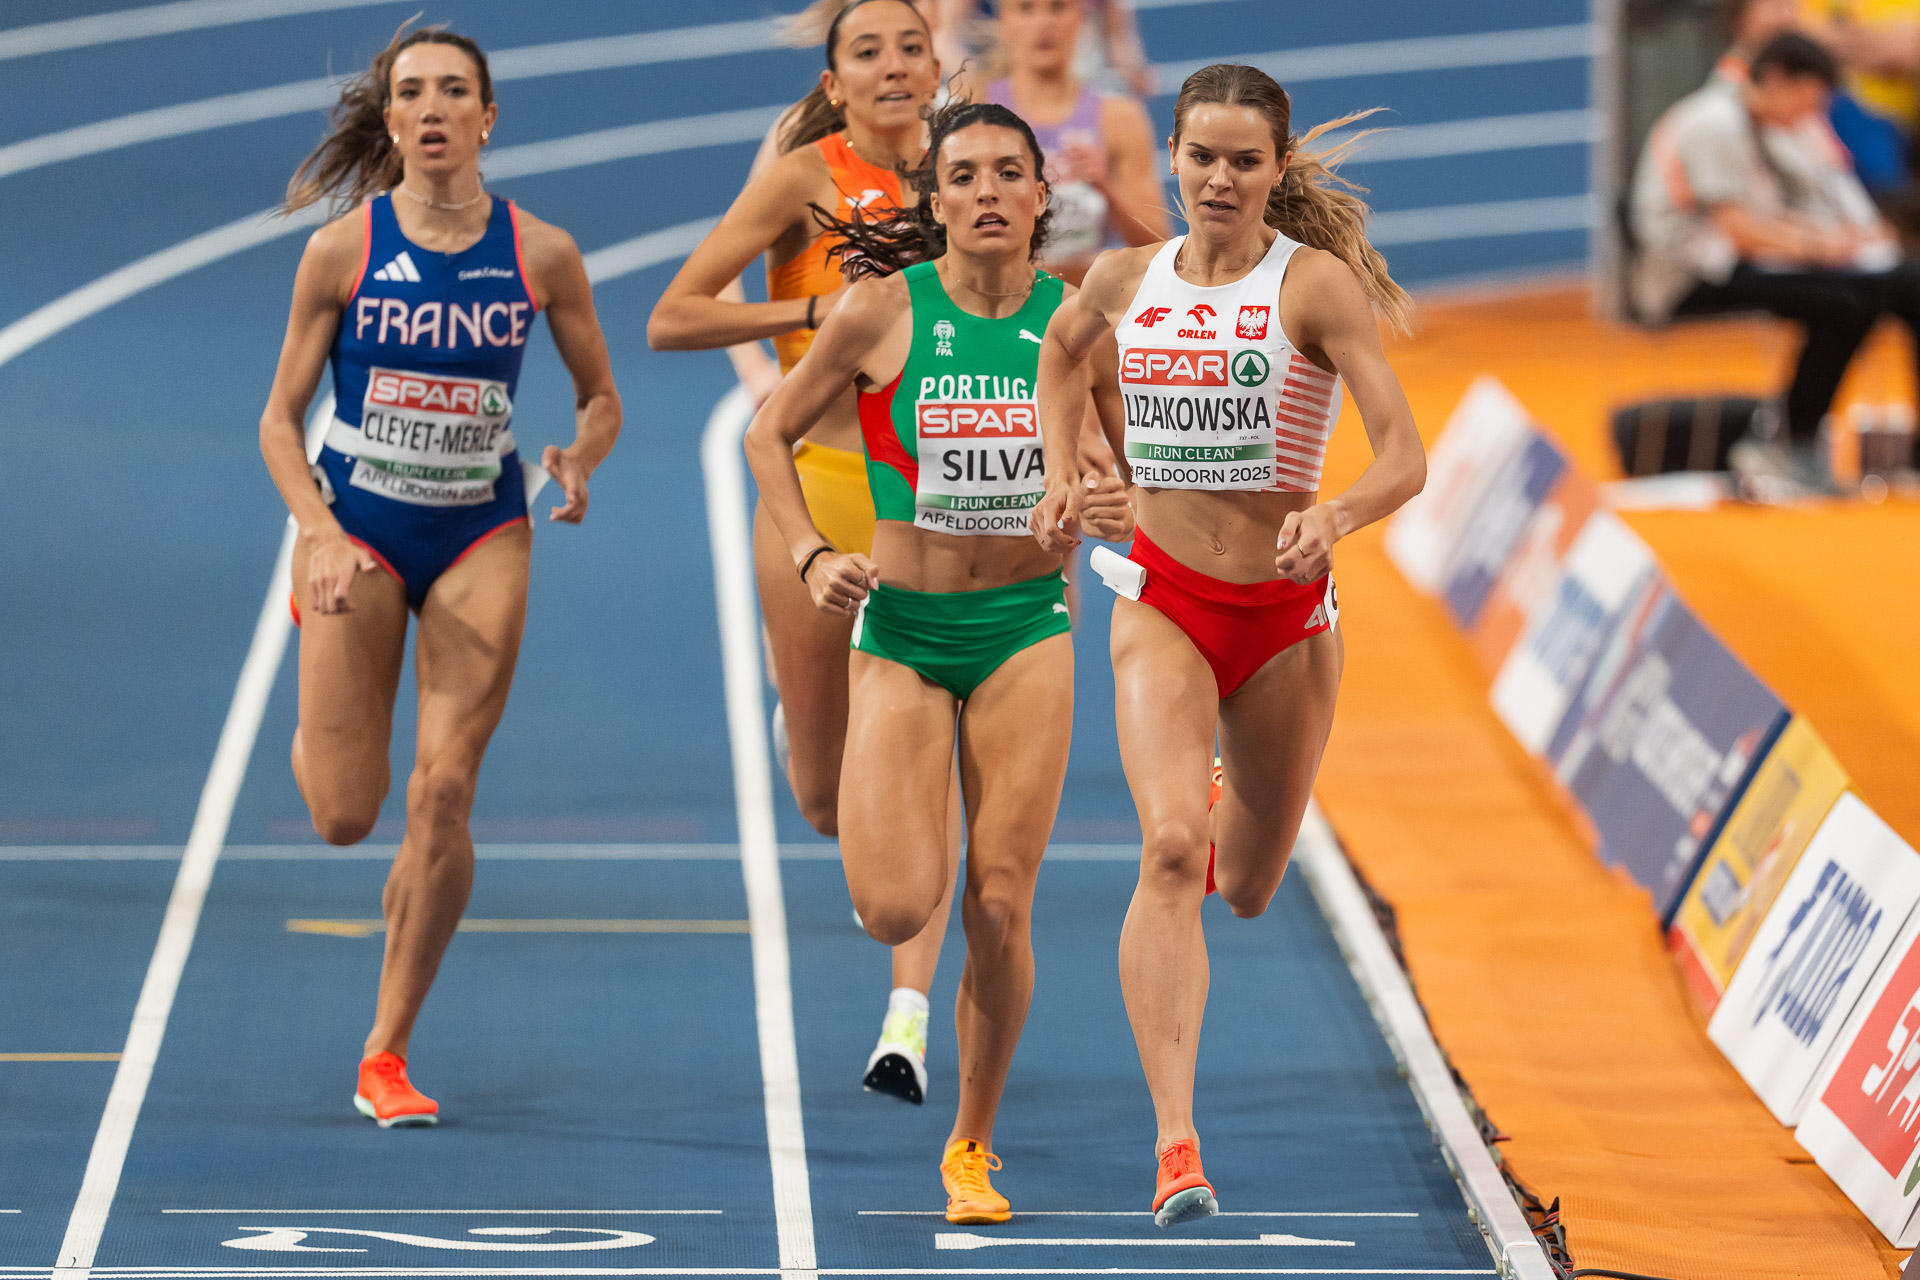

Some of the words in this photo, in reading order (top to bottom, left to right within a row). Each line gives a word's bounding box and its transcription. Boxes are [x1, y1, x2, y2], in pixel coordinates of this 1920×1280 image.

[356, 296, 529, 349] FRANCE
[1134, 306, 1173, 328] 4F
[1177, 328, 1217, 340] ORLEN
[935, 347, 954, 357] FPA
[1123, 352, 1225, 382] SPAR
[372, 374, 477, 412] SPAR
[918, 374, 1038, 400] PORTUG
[921, 407, 1035, 434] SPAR
[1124, 393, 1272, 432] LIZAKOWSKA
[363, 411, 500, 455] CLEYET-MERLE
[942, 447, 1045, 482] SILVA
[1148, 445, 1152, 458] I
[1153, 446, 1183, 460] RUN
[1229, 465, 1271, 483] 2025
[950, 497, 956, 509] I
[957, 497, 990, 510] RUN
[921, 511, 1028, 531] APELDOORN
